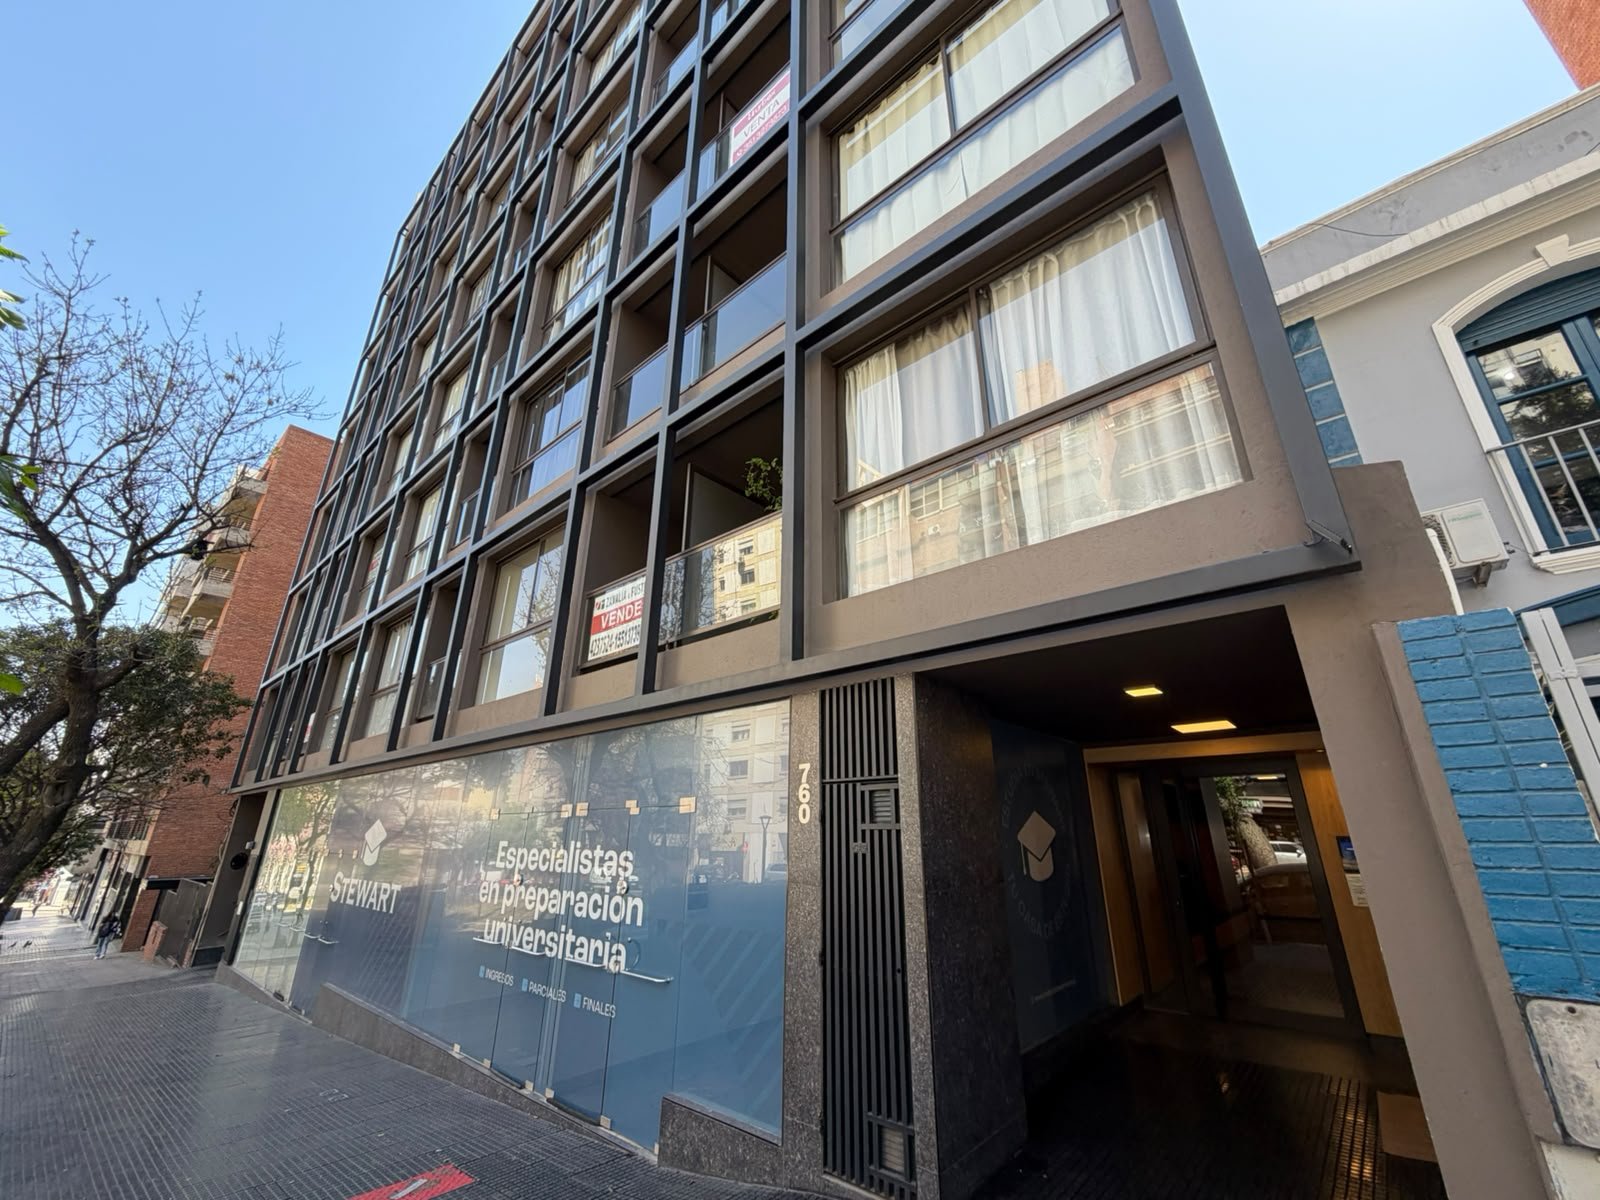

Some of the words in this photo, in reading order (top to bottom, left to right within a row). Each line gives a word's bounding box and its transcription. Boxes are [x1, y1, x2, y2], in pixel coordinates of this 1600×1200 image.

[743, 99, 780, 137] VENTA
[601, 600, 642, 630] VENDE
[798, 763, 811, 824] 760
[495, 840, 634, 878] Especialistas
[330, 871, 401, 914] STEWART
[479, 881, 499, 903] en
[501, 883, 644, 927] preparación
[483, 918, 627, 973] universitaria
[485, 967, 514, 987] INGRESOS
[529, 981, 567, 1003] PARCIALES
[583, 996, 616, 1018] FINALES
